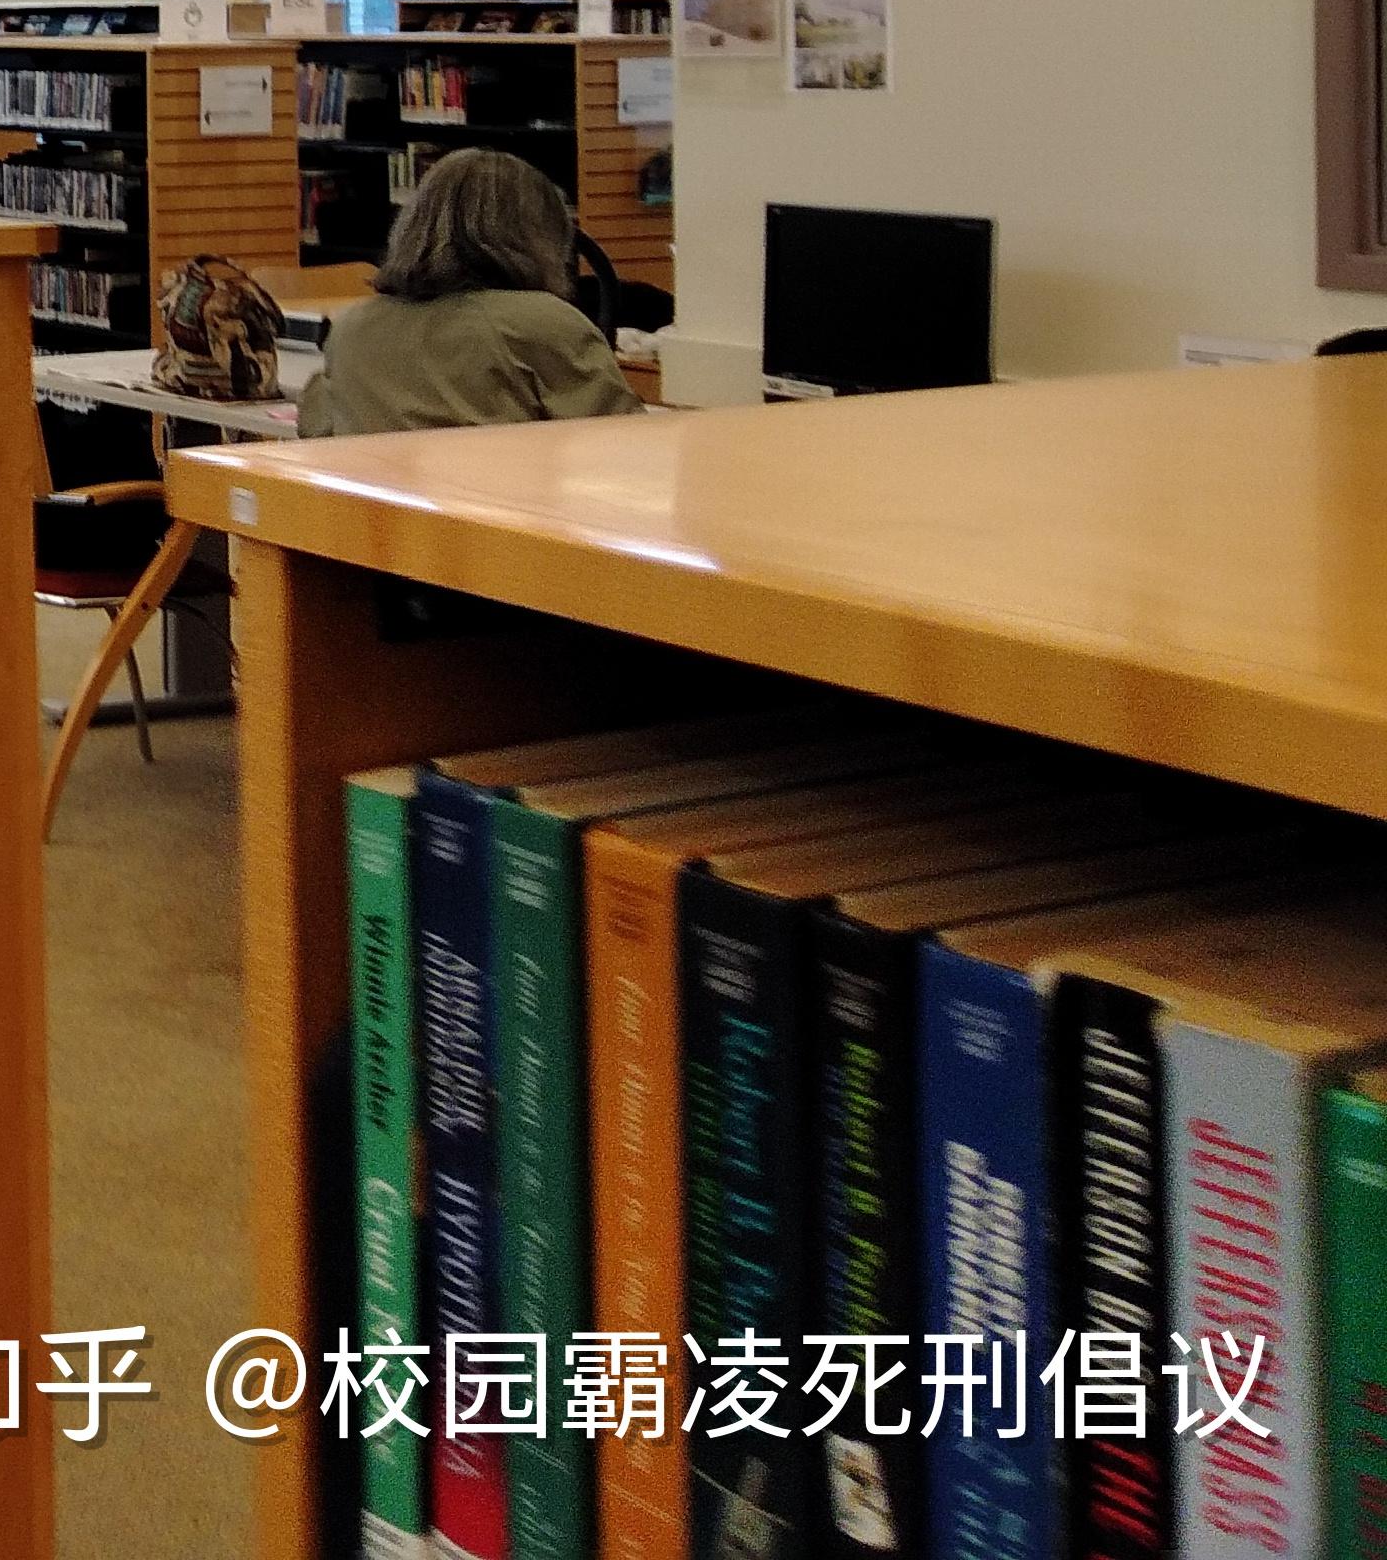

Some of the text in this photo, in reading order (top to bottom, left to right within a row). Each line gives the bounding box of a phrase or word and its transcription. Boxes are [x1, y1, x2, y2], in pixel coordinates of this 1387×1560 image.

[362, 914, 394, 1022] Winnie
[366, 1029, 397, 1134] Archer
[720, 1013, 776, 1176] Robert
[841, 1039, 885, 1178] Robert
[1082, 1027, 1153, 1287] JEFFERSON
[364, 1177, 405, 1295] Crust
[981, 1177, 1028, 1349] ROBERT
[1187, 1117, 1287, 1415] JEFFERSON
